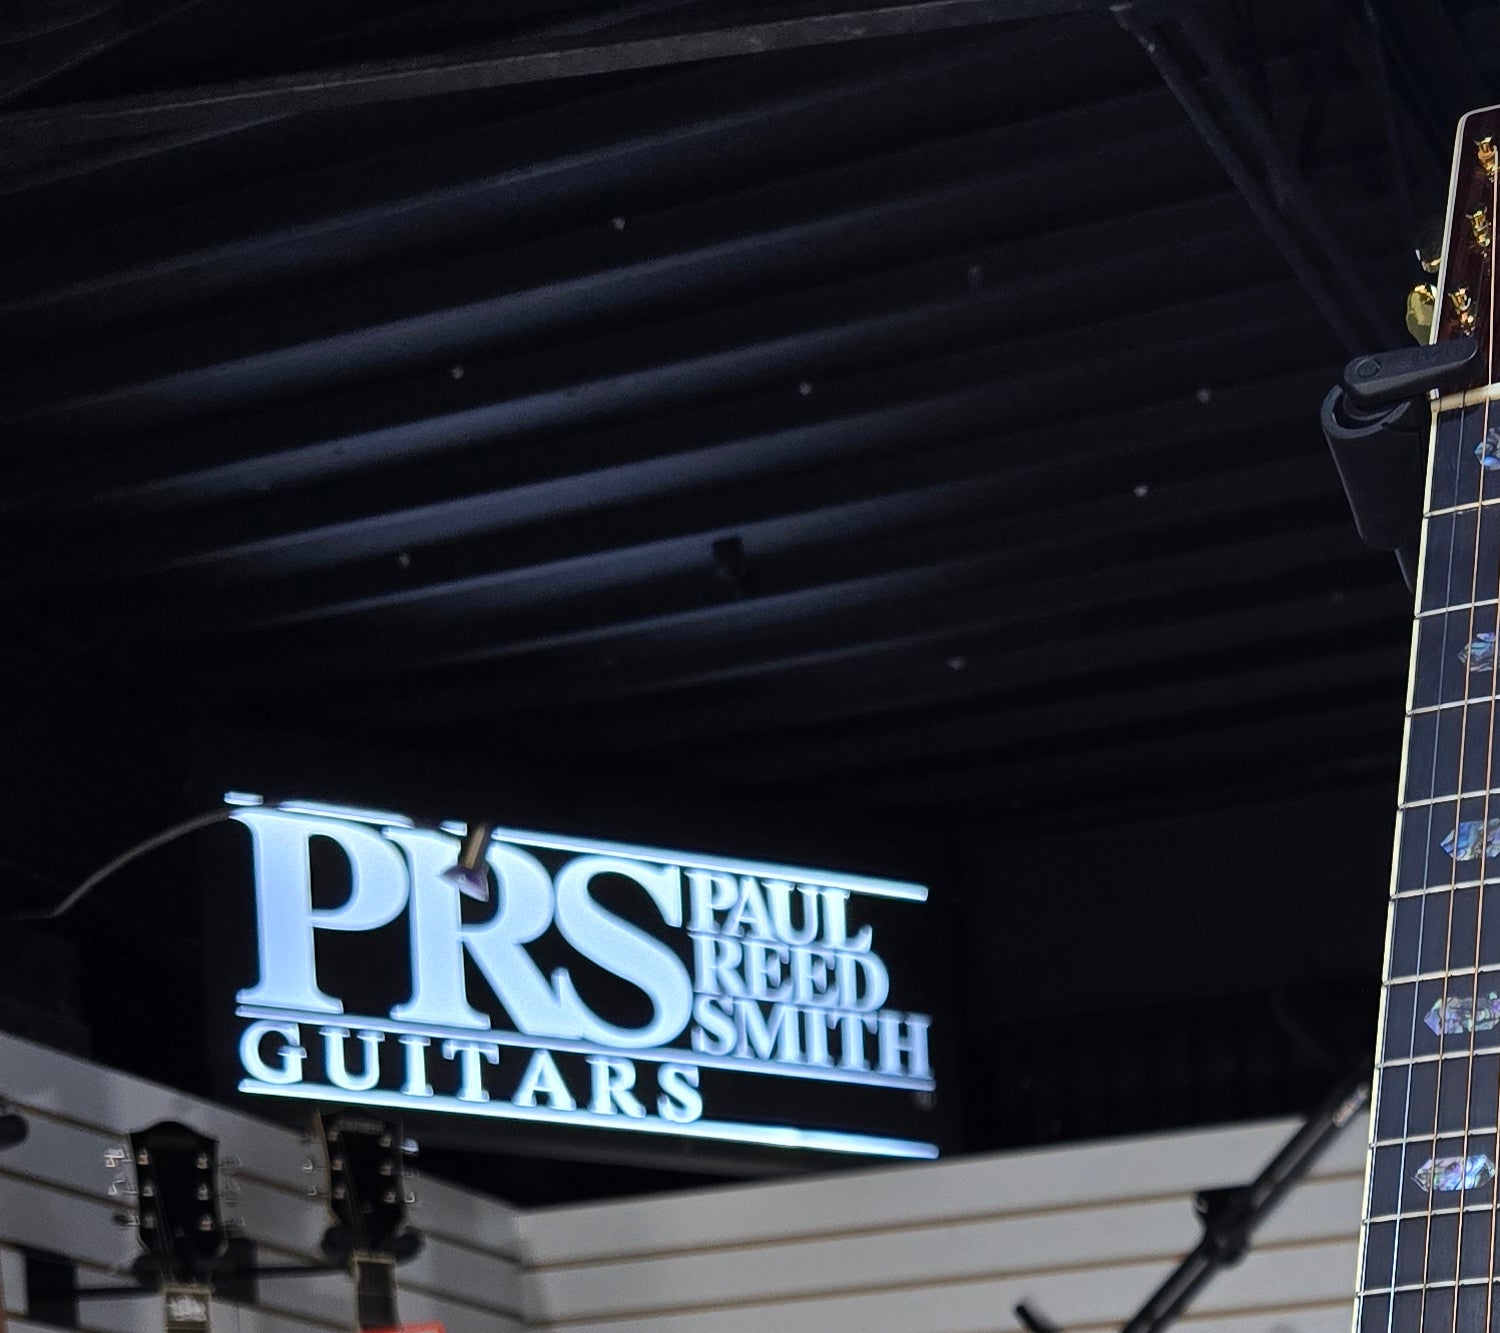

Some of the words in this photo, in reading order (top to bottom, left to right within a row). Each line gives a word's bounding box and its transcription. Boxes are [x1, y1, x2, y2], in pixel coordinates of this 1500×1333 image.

[229, 806, 693, 1049] PRS
[684, 867, 873, 950] PAUL
[689, 933, 890, 1012] REED
[237, 1020, 704, 1125] GUITARS
[692, 997, 934, 1083] SMITH
